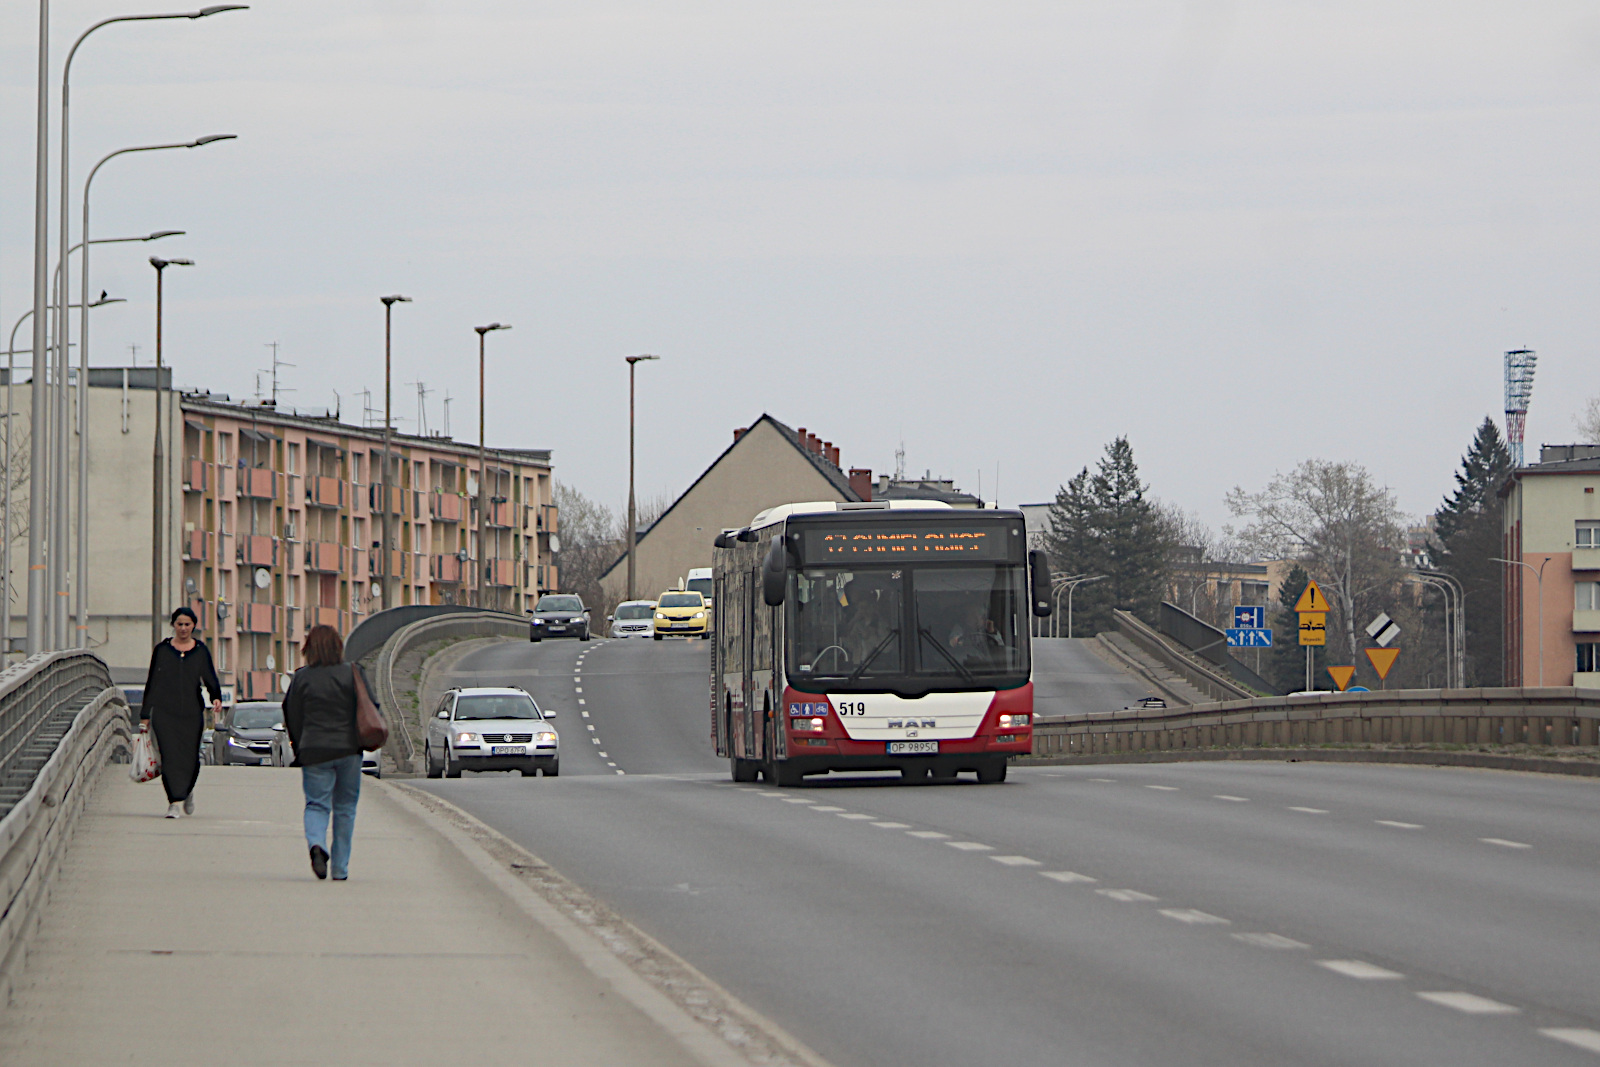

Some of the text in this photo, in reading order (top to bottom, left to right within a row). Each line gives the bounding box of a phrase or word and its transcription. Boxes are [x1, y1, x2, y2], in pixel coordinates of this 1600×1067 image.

[839, 702, 865, 716] 519
[887, 717, 936, 728] MAN
[891, 742, 936, 752] OP 9895C
